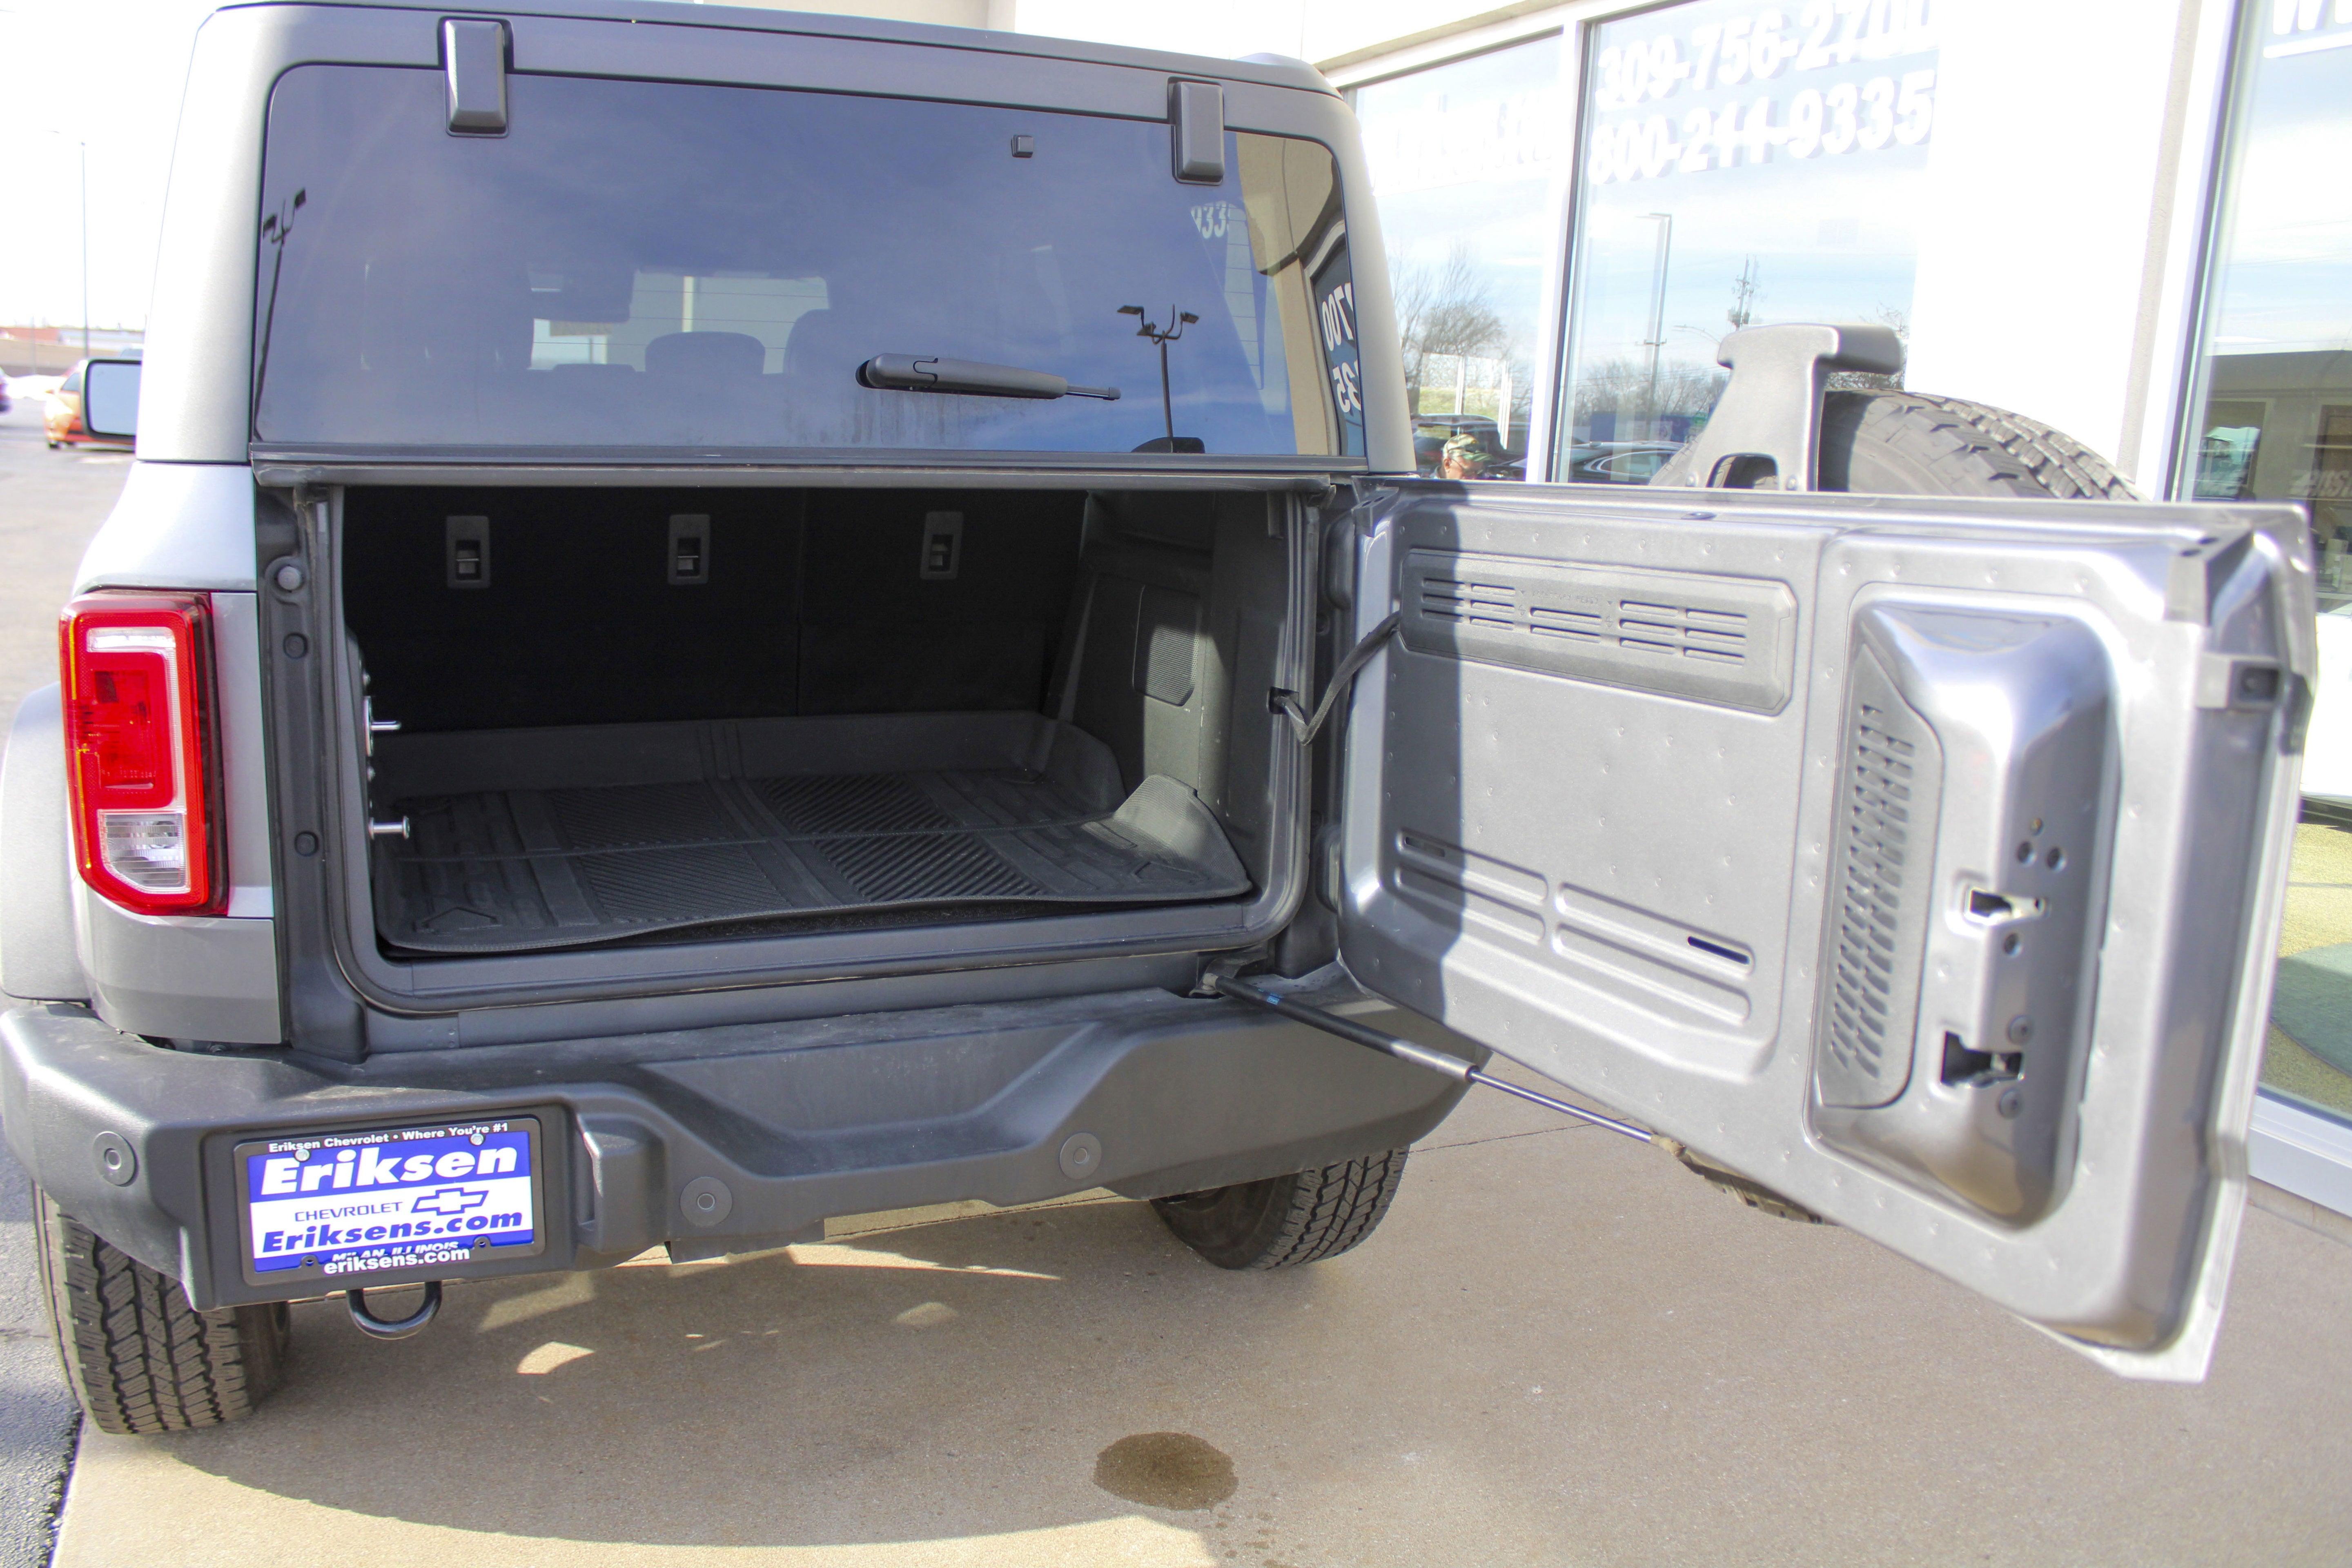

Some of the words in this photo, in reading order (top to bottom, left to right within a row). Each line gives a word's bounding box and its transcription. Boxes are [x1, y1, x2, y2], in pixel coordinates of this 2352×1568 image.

[1588, 69, 1935, 185] 800-211-9335
[268, 1140, 321, 1153] Eriksen
[324, 1134, 389, 1147] Chevrolet
[402, 1130, 445, 1140] Where
[448, 1125, 489, 1136] You're
[493, 1123, 508, 1132] #1
[261, 1147, 517, 1195] Eriksen
[295, 1202, 403, 1222] CHEVROLET
[262, 1212, 522, 1253] Eriksens.com
[324, 1248, 470, 1274] eriksens.com
